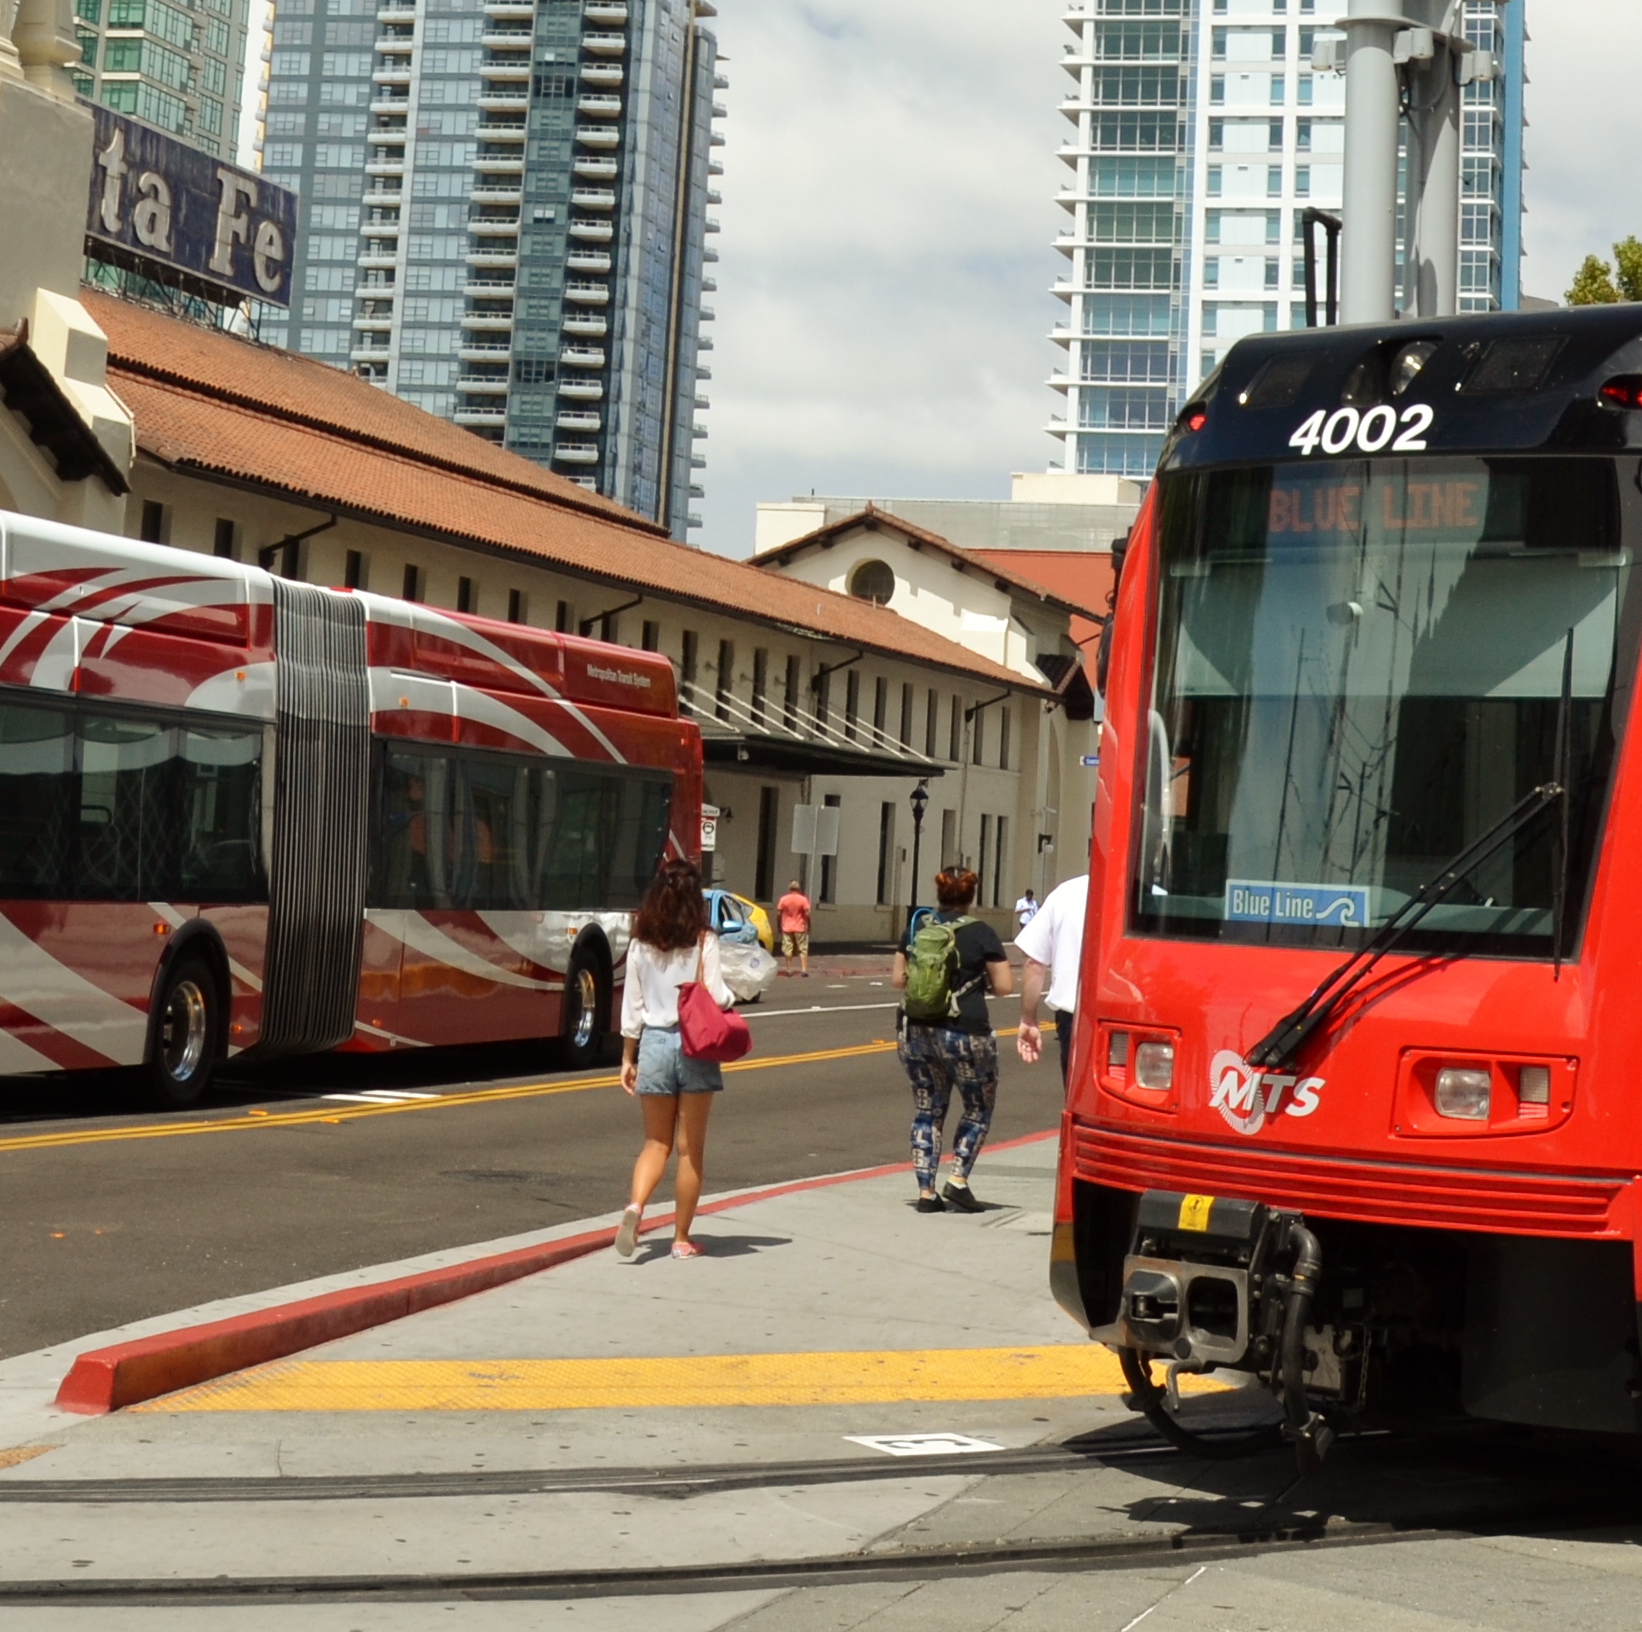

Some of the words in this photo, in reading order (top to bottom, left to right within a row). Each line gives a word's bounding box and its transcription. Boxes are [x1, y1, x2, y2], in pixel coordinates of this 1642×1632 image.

[208, 167, 285, 293] Fe
[1288, 403, 1434, 456] 4002
[1267, 486, 1361, 533] BLUE
[1381, 482, 1478, 530] LINE
[586, 663, 617, 683] Metropolitan
[617, 669, 633, 685] Transit
[633, 672, 651, 689] System
[1233, 889, 1270, 916] Blue
[1275, 891, 1313, 918] Line
[1208, 1070, 1326, 1117] MTS
